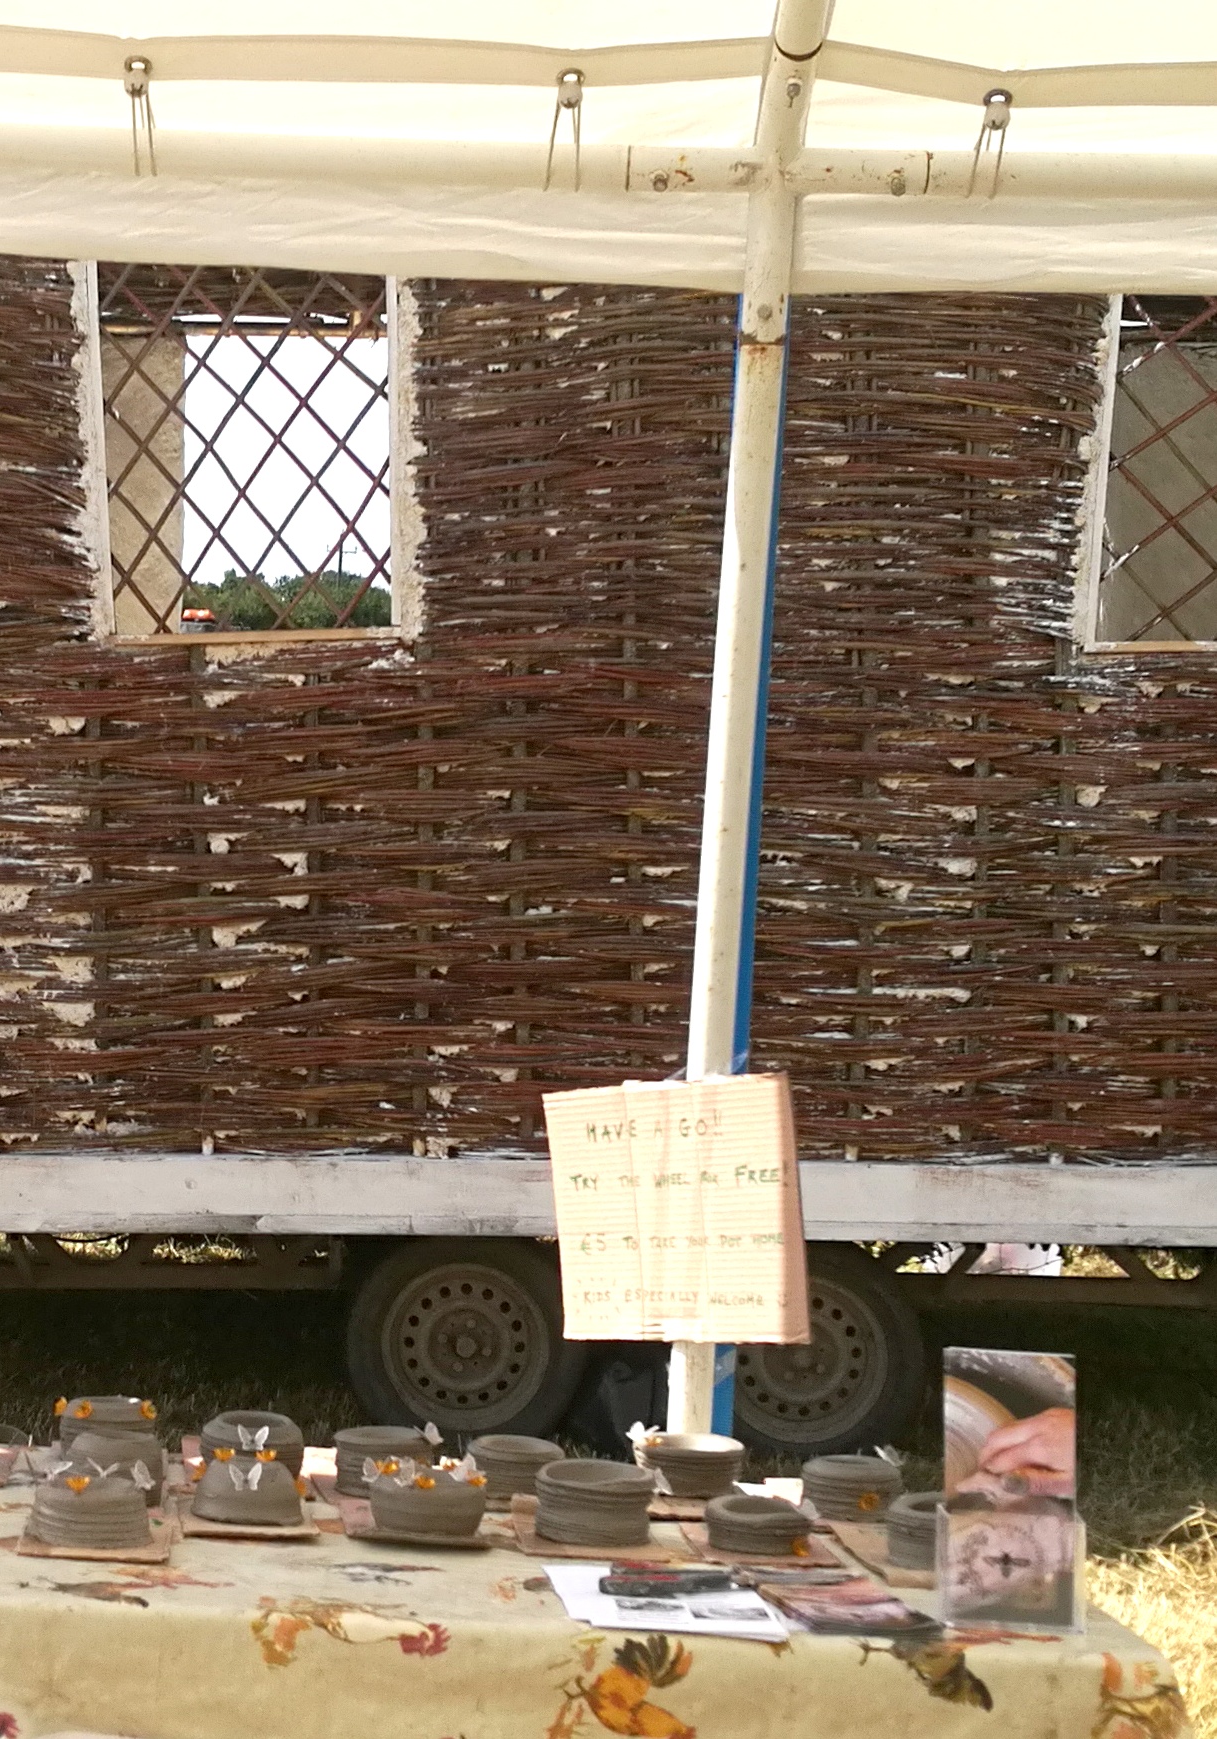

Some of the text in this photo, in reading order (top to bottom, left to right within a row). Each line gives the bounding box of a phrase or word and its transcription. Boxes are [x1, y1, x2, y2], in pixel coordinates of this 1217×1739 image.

[586, 1119, 637, 1143] HAVE
[654, 1121, 664, 1138] A
[569, 1174, 598, 1192] TRY
